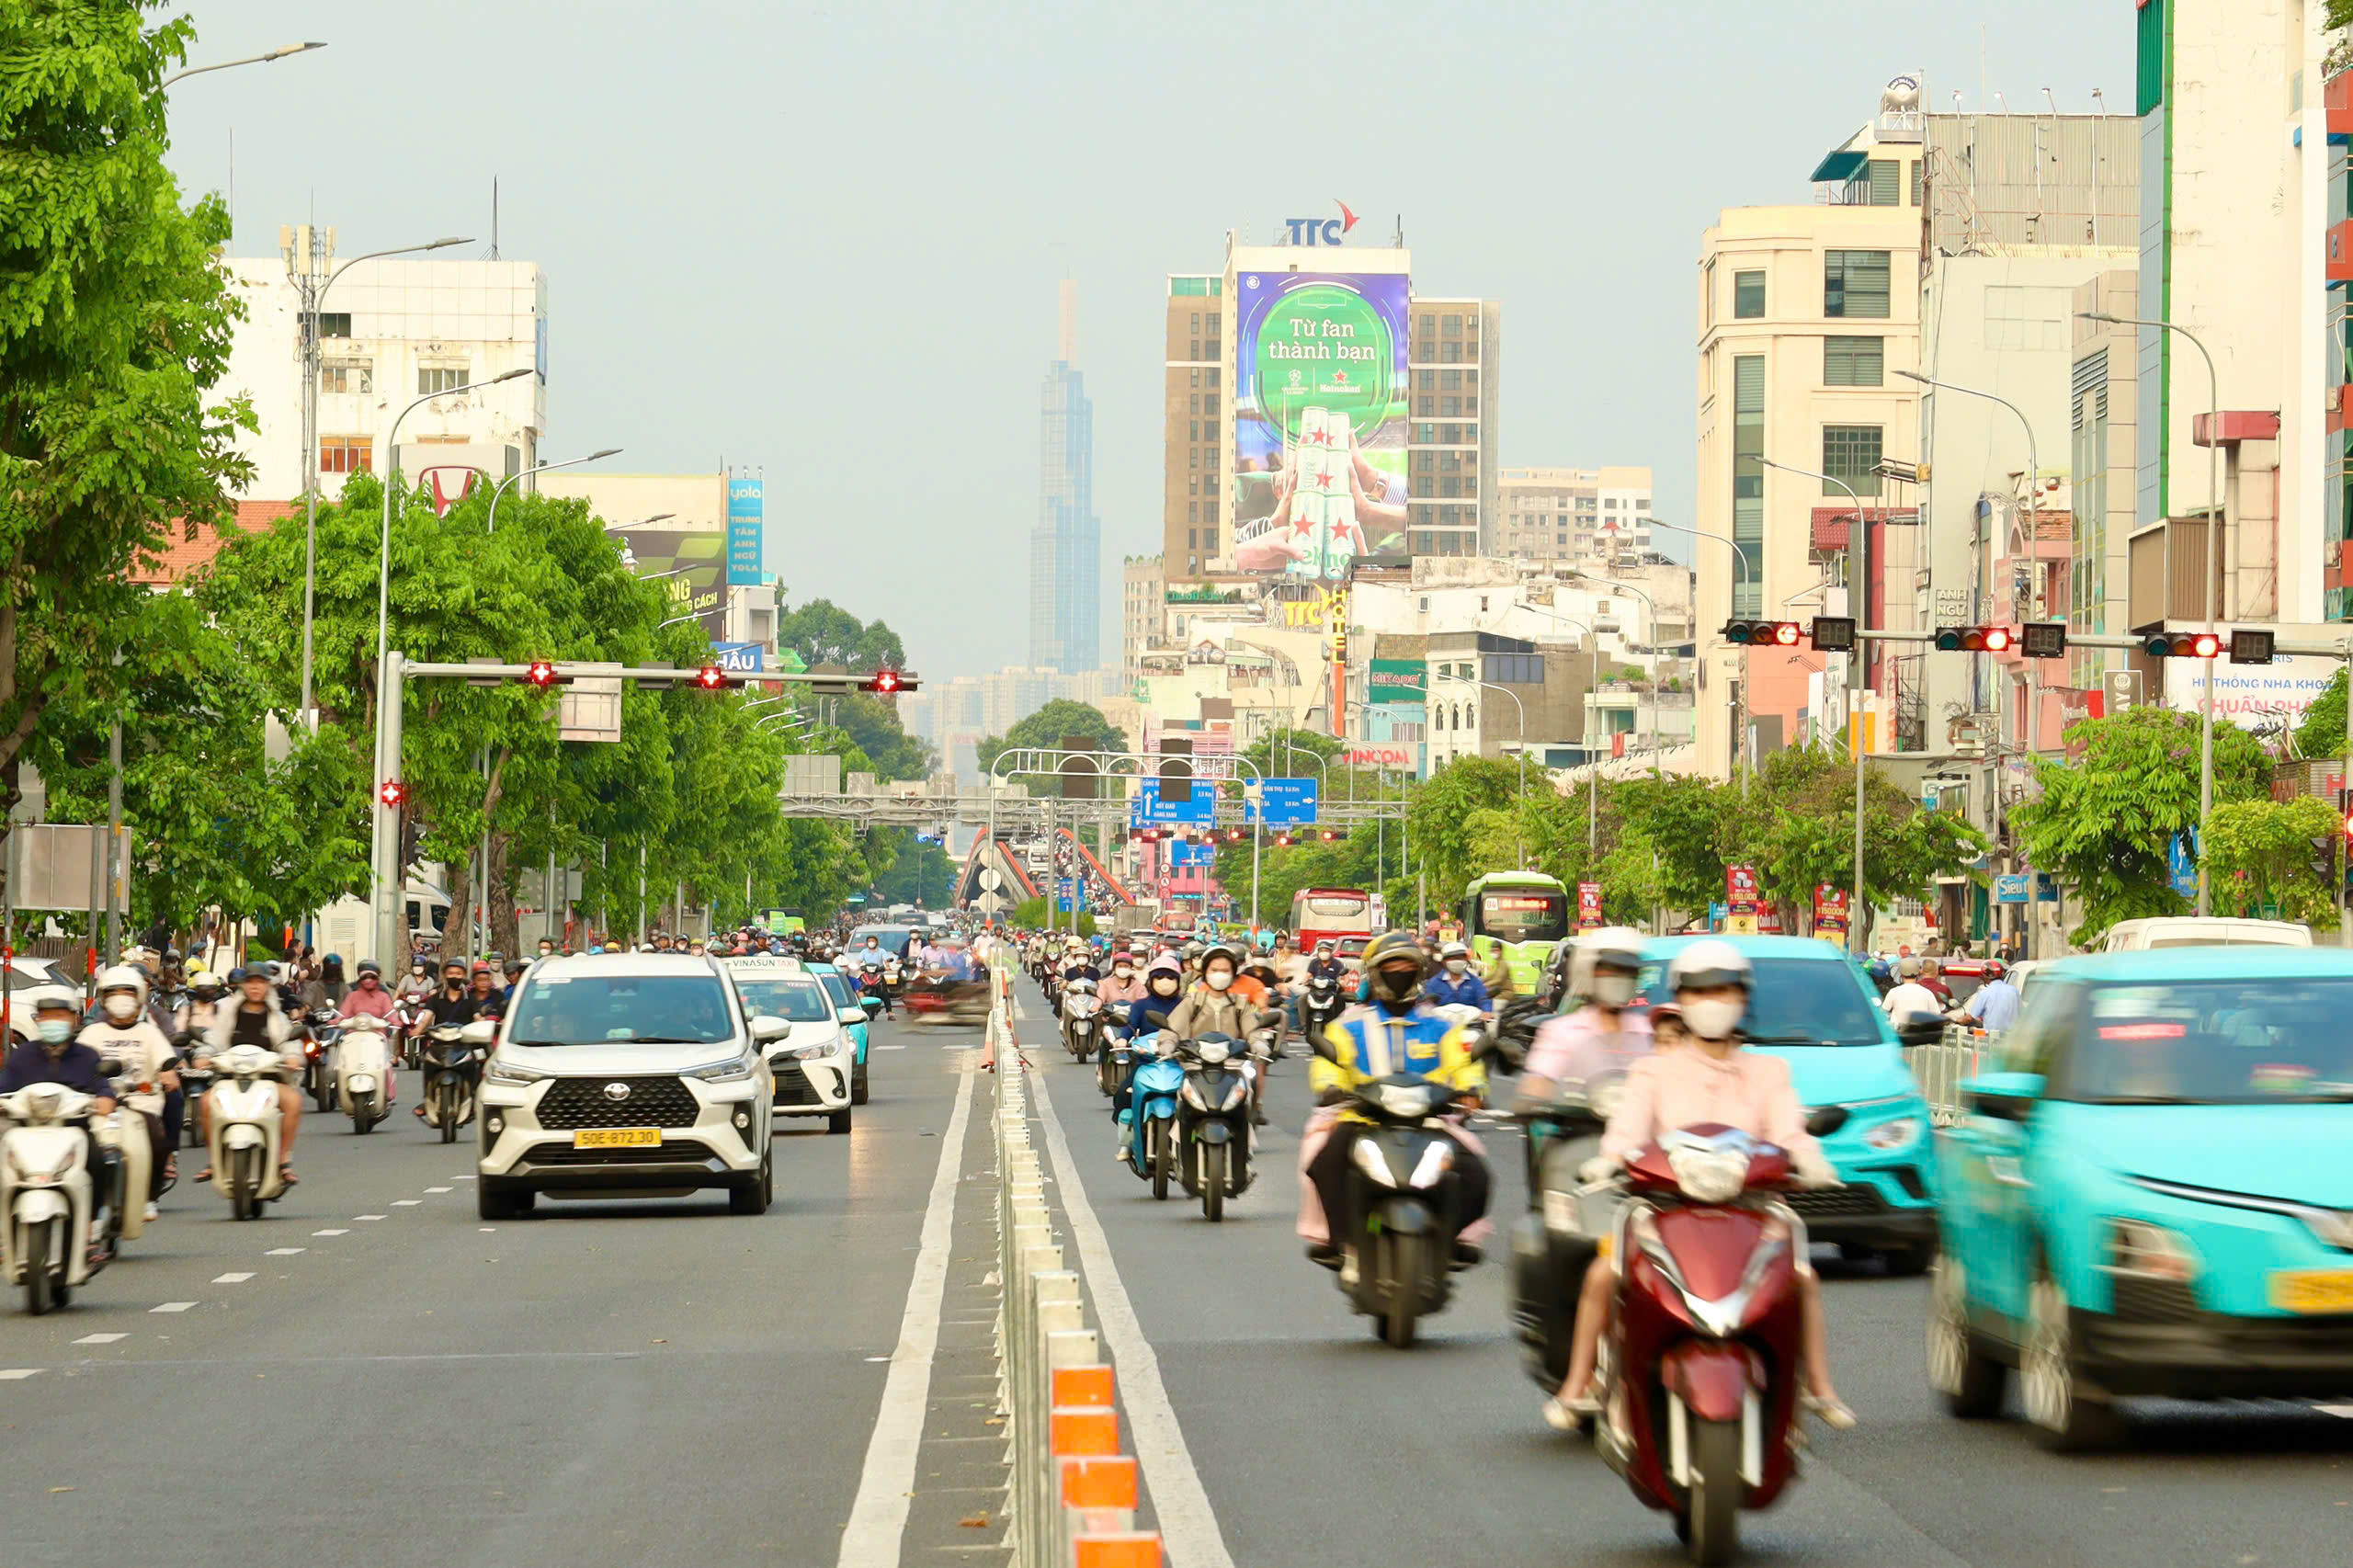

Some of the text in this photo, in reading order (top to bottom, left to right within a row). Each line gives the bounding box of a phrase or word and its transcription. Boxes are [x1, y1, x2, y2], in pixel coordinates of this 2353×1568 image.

[1286, 219, 1342, 245] TTC
[1290, 318, 1355, 337] Từ fan
[1268, 341, 1375, 364] thành bạn
[731, 485, 761, 500] yola
[694, 592, 718, 609] CÁCH
[1937, 589, 1967, 600] ANH
[1282, 602, 1324, 626] TTC
[1332, 588, 1346, 664] HOTEL
[1372, 674, 1420, 685] MIKADO
[2264, 679, 2291, 688] NHA
[1342, 750, 1410, 764] VINCOM
[733, 959, 795, 968] VINASUN TAXI
